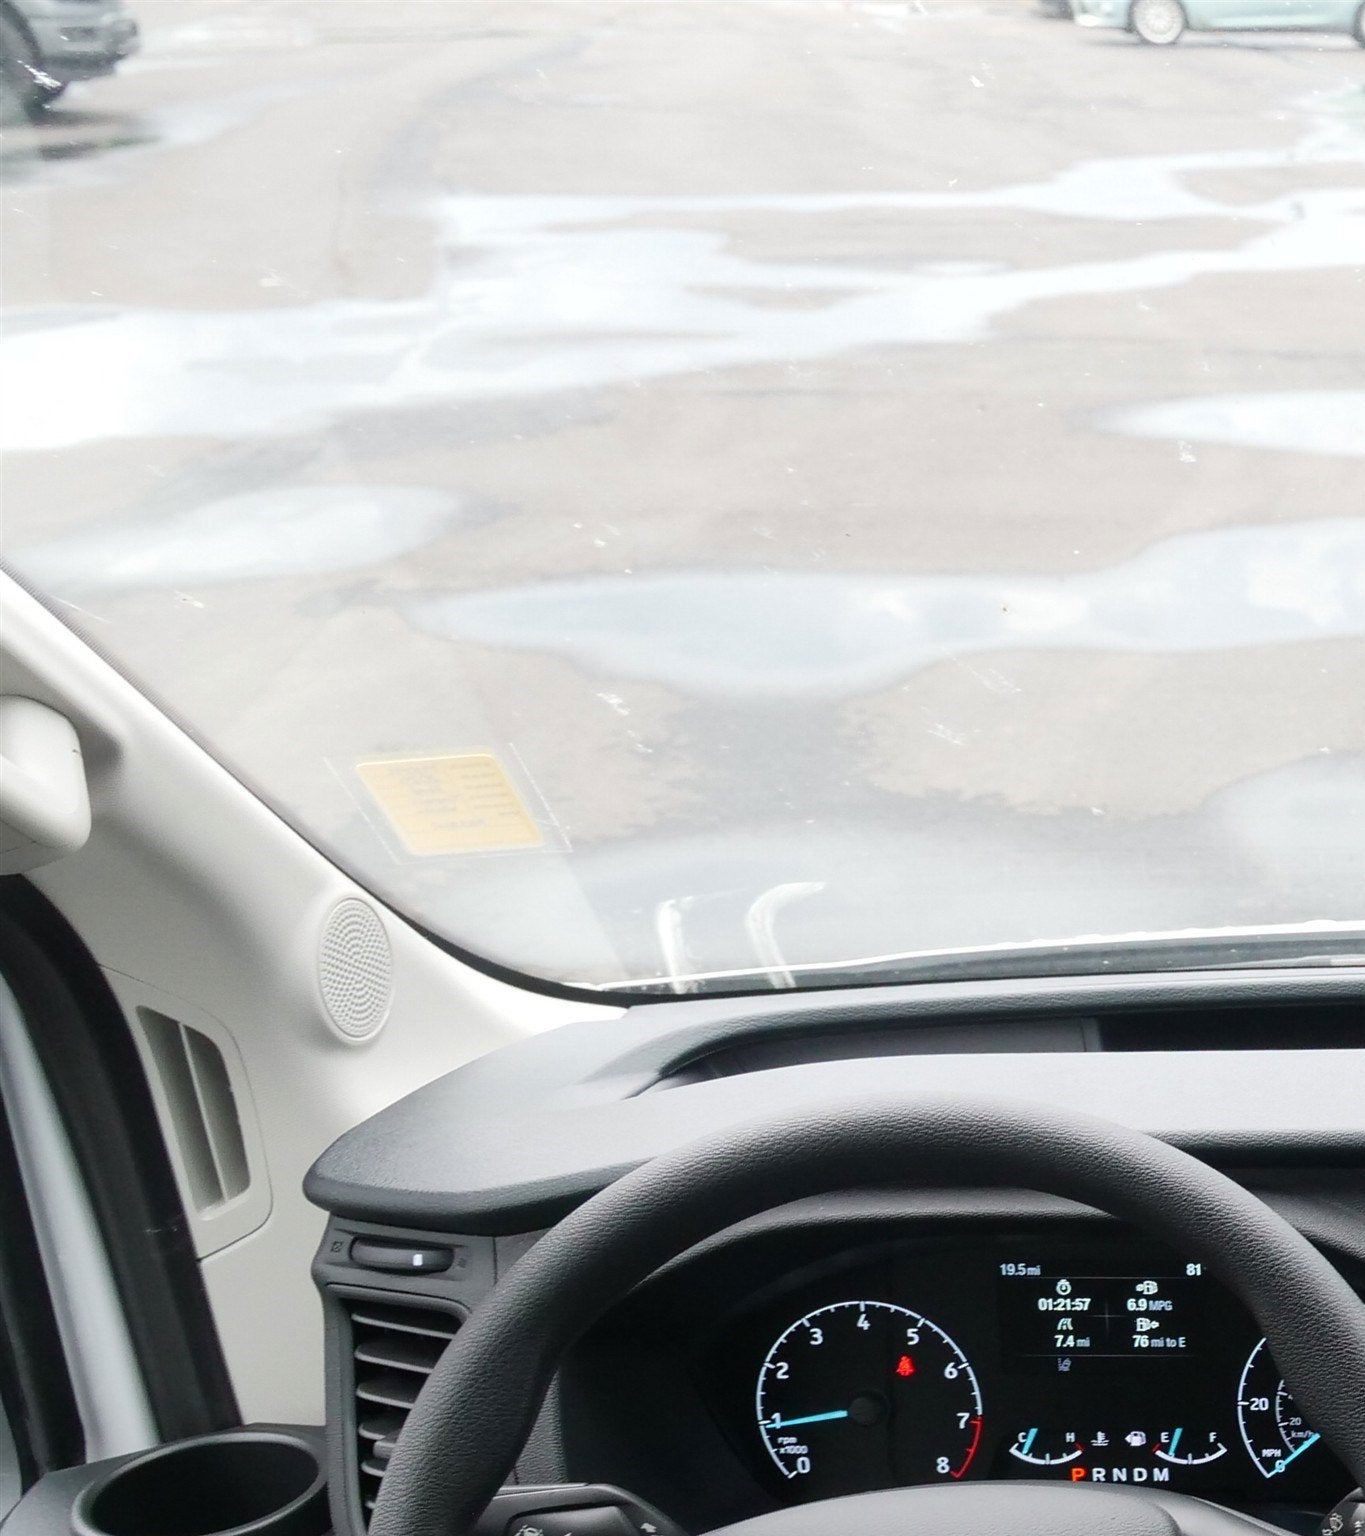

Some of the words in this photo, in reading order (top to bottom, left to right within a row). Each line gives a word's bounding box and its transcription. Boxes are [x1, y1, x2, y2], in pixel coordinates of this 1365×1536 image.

[1038, 1298, 1092, 1312] 01:21:57
[1126, 1298, 1148, 1312] 6.9
[1148, 1300, 1173, 1311] MPG
[856, 1314, 871, 1331] 4
[809, 1328, 824, 1345] 3
[906, 1328, 920, 1345] 5
[1054, 1335, 1075, 1348] 7.4
[1076, 1337, 1091, 1348] mi
[1132, 1335, 1149, 1348] 76
[1150, 1337, 1165, 1348] mi
[1165, 1337, 1177, 1348] to
[1178, 1337, 1187, 1348] E
[775, 1362, 790, 1380] 2
[943, 1362, 958, 1380] 6
[1249, 1397, 1269, 1412] 20
[956, 1412, 970, 1429] 7
[1289, 1417, 1303, 1426] 20
[777, 1437, 798, 1446] rpm
[1017, 1431, 1027, 1443] C
[1065, 1431, 1075, 1443] H
[1160, 1431, 1170, 1443] E
[1209, 1431, 1217, 1443] F
[779, 1445, 809, 1454] x1000
[1261, 1449, 1282, 1457] MPH
[796, 1456, 811, 1474] 0
[935, 1456, 951, 1474] 8
[1071, 1468, 1085, 1482] P
[1092, 1468, 1106, 1482] R
[1112, 1468, 1127, 1482] N
[1133, 1468, 1148, 1482] D
[1153, 1468, 1170, 1482] M
